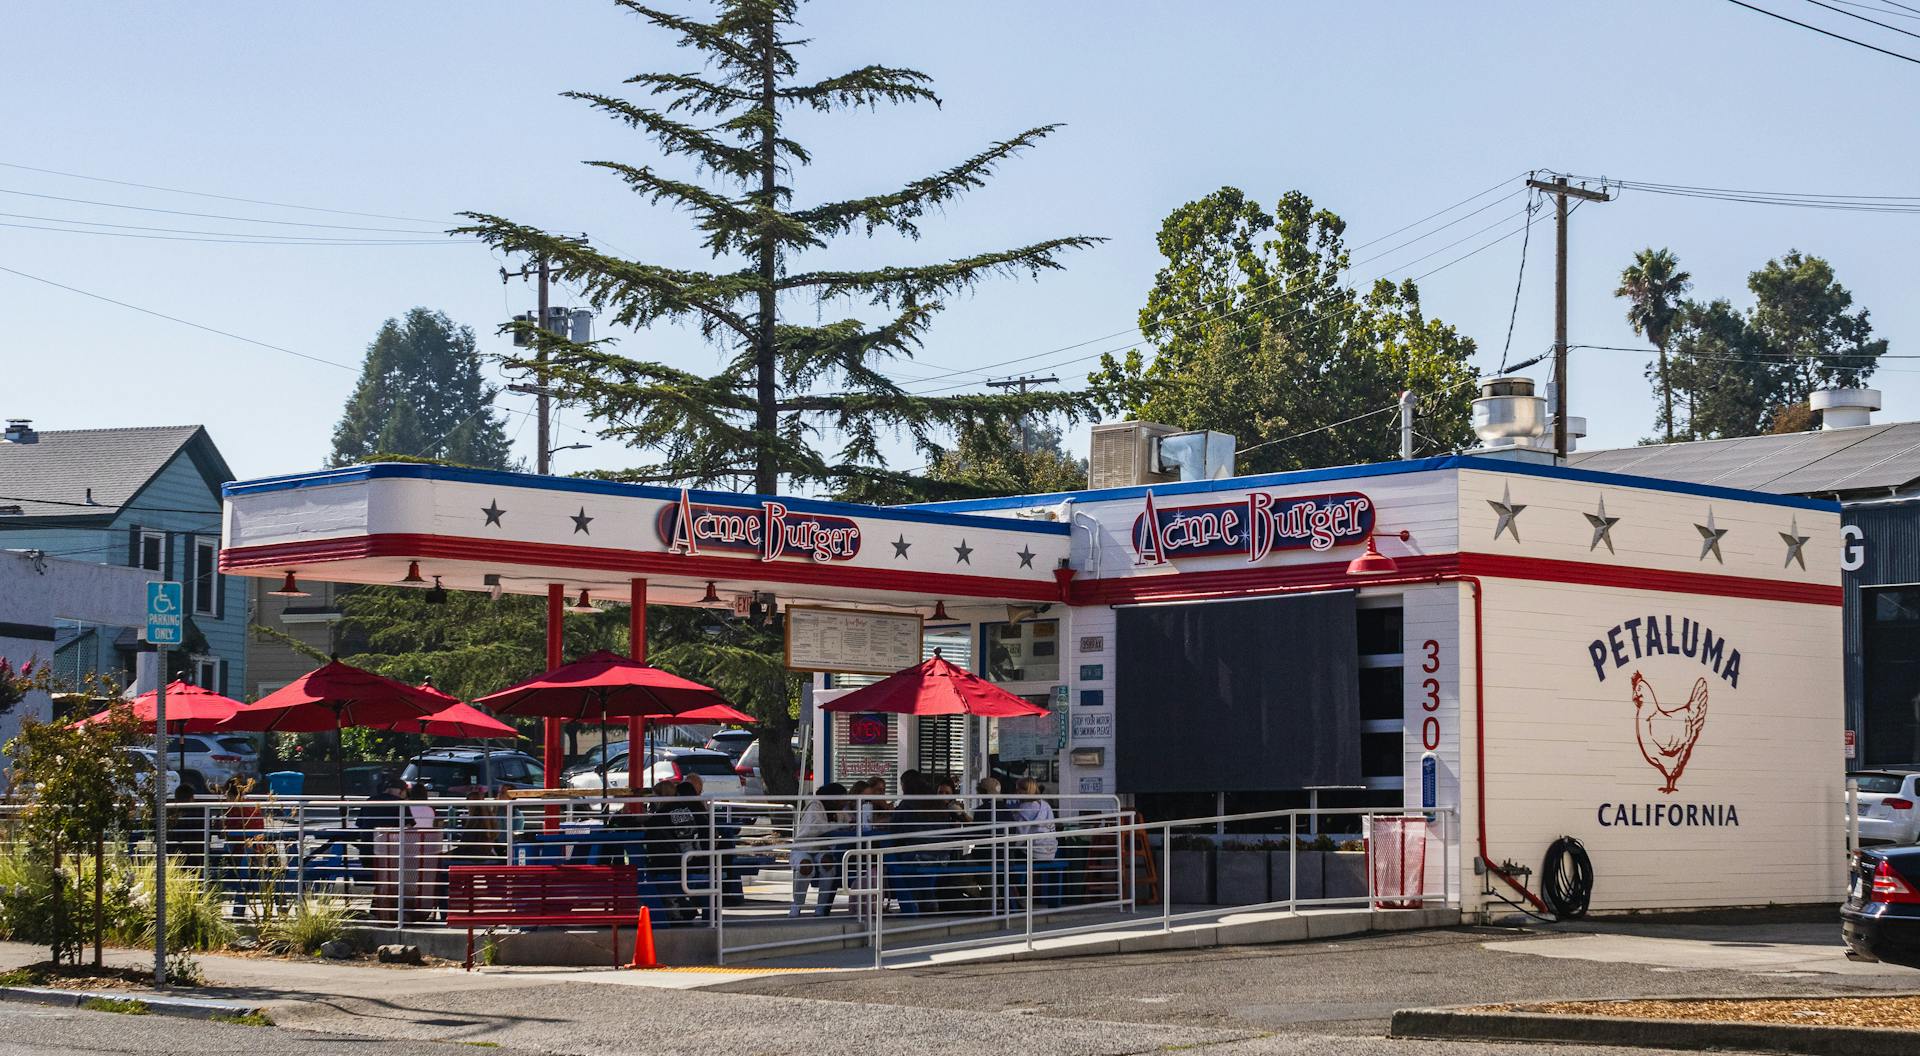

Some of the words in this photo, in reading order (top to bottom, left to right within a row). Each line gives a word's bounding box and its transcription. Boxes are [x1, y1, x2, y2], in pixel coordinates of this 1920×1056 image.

[668, 487, 760, 556] Acme
[762, 502, 859, 563] Burger
[1133, 488, 1239, 566] Acme
[1247, 491, 1369, 564] Burger
[149, 614, 180, 626] PARKING
[154, 628, 175, 640] ONLY
[1588, 615, 1742, 689] PETALUMA
[1422, 639, 1441, 751] 330
[1079, 727, 1096, 736] SMOKING
[1097, 726, 1110, 736] PLEASE
[1085, 716, 1096, 726] YOUR
[1096, 715, 1110, 725] MOTOR
[1597, 803, 1740, 827] CALIFORNIA
